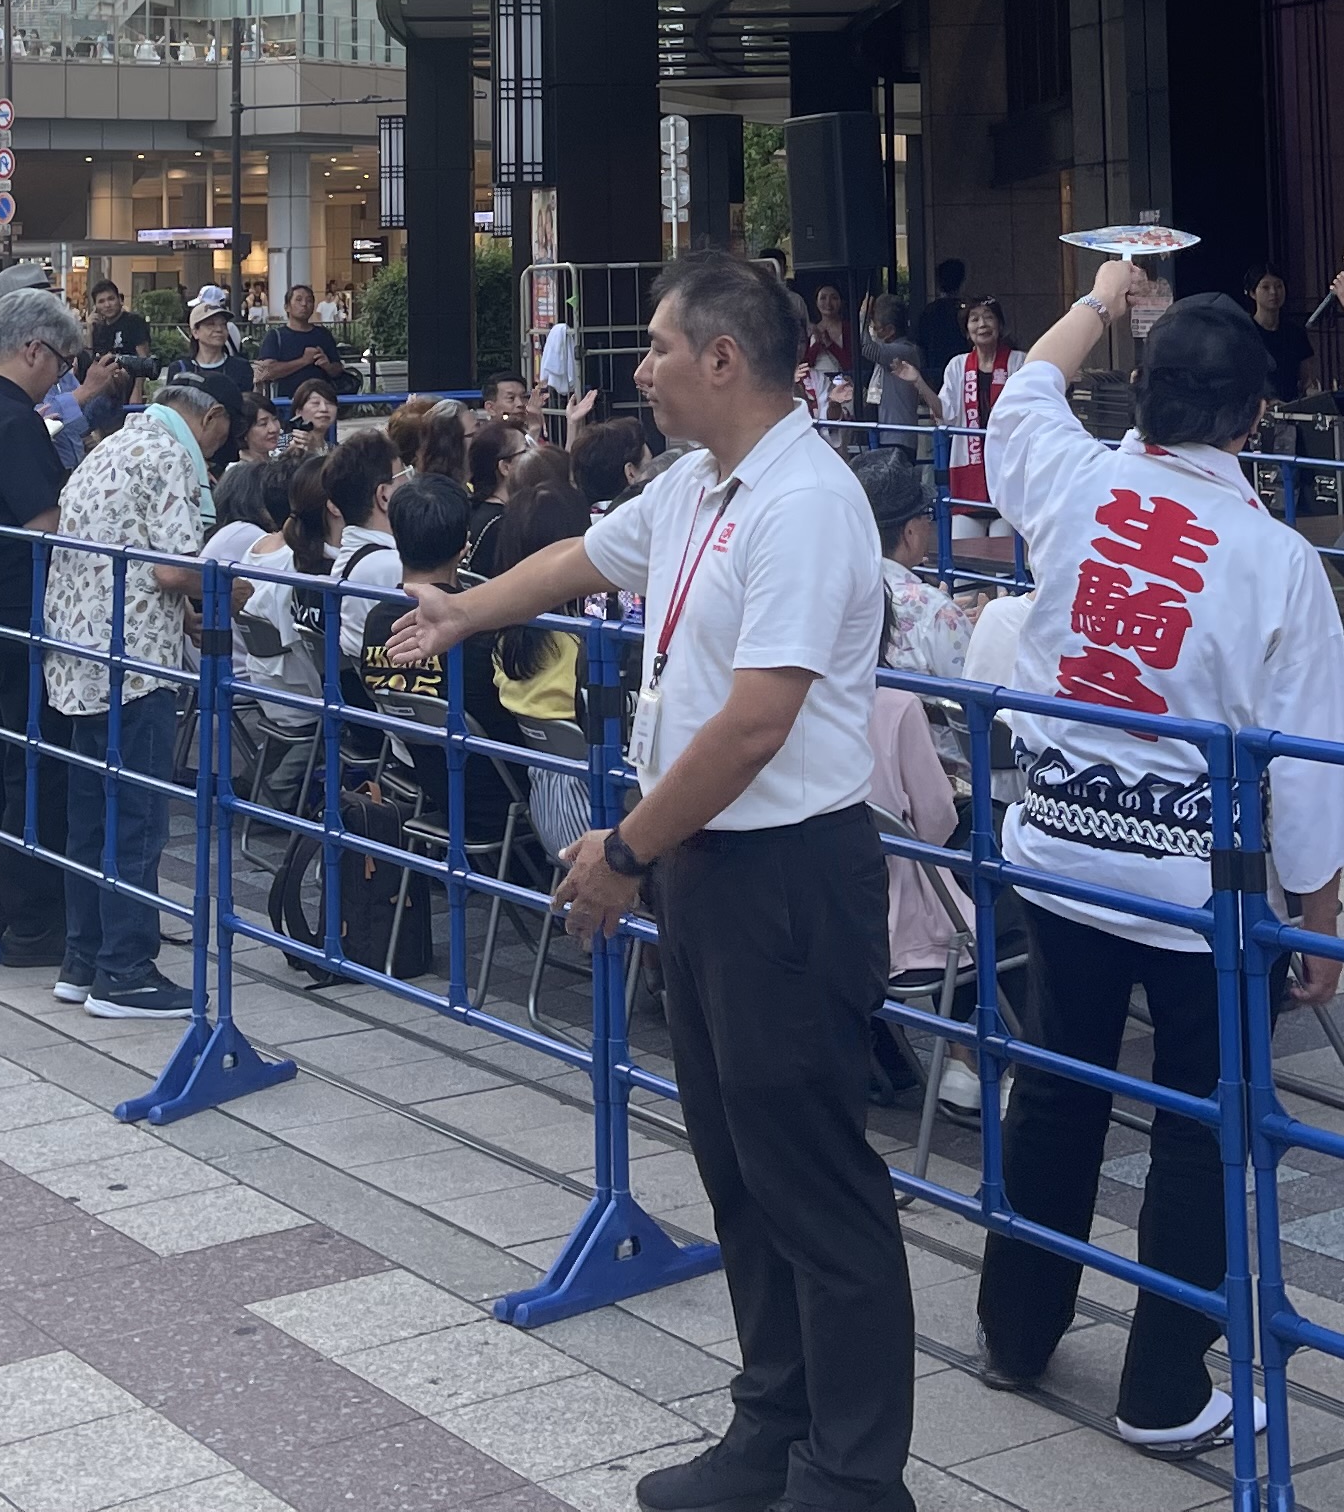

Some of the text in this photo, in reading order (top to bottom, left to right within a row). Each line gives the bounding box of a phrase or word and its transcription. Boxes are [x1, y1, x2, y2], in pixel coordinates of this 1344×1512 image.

[964, 369, 982, 465] BON DANCE
[365, 645, 444, 673] IKA
